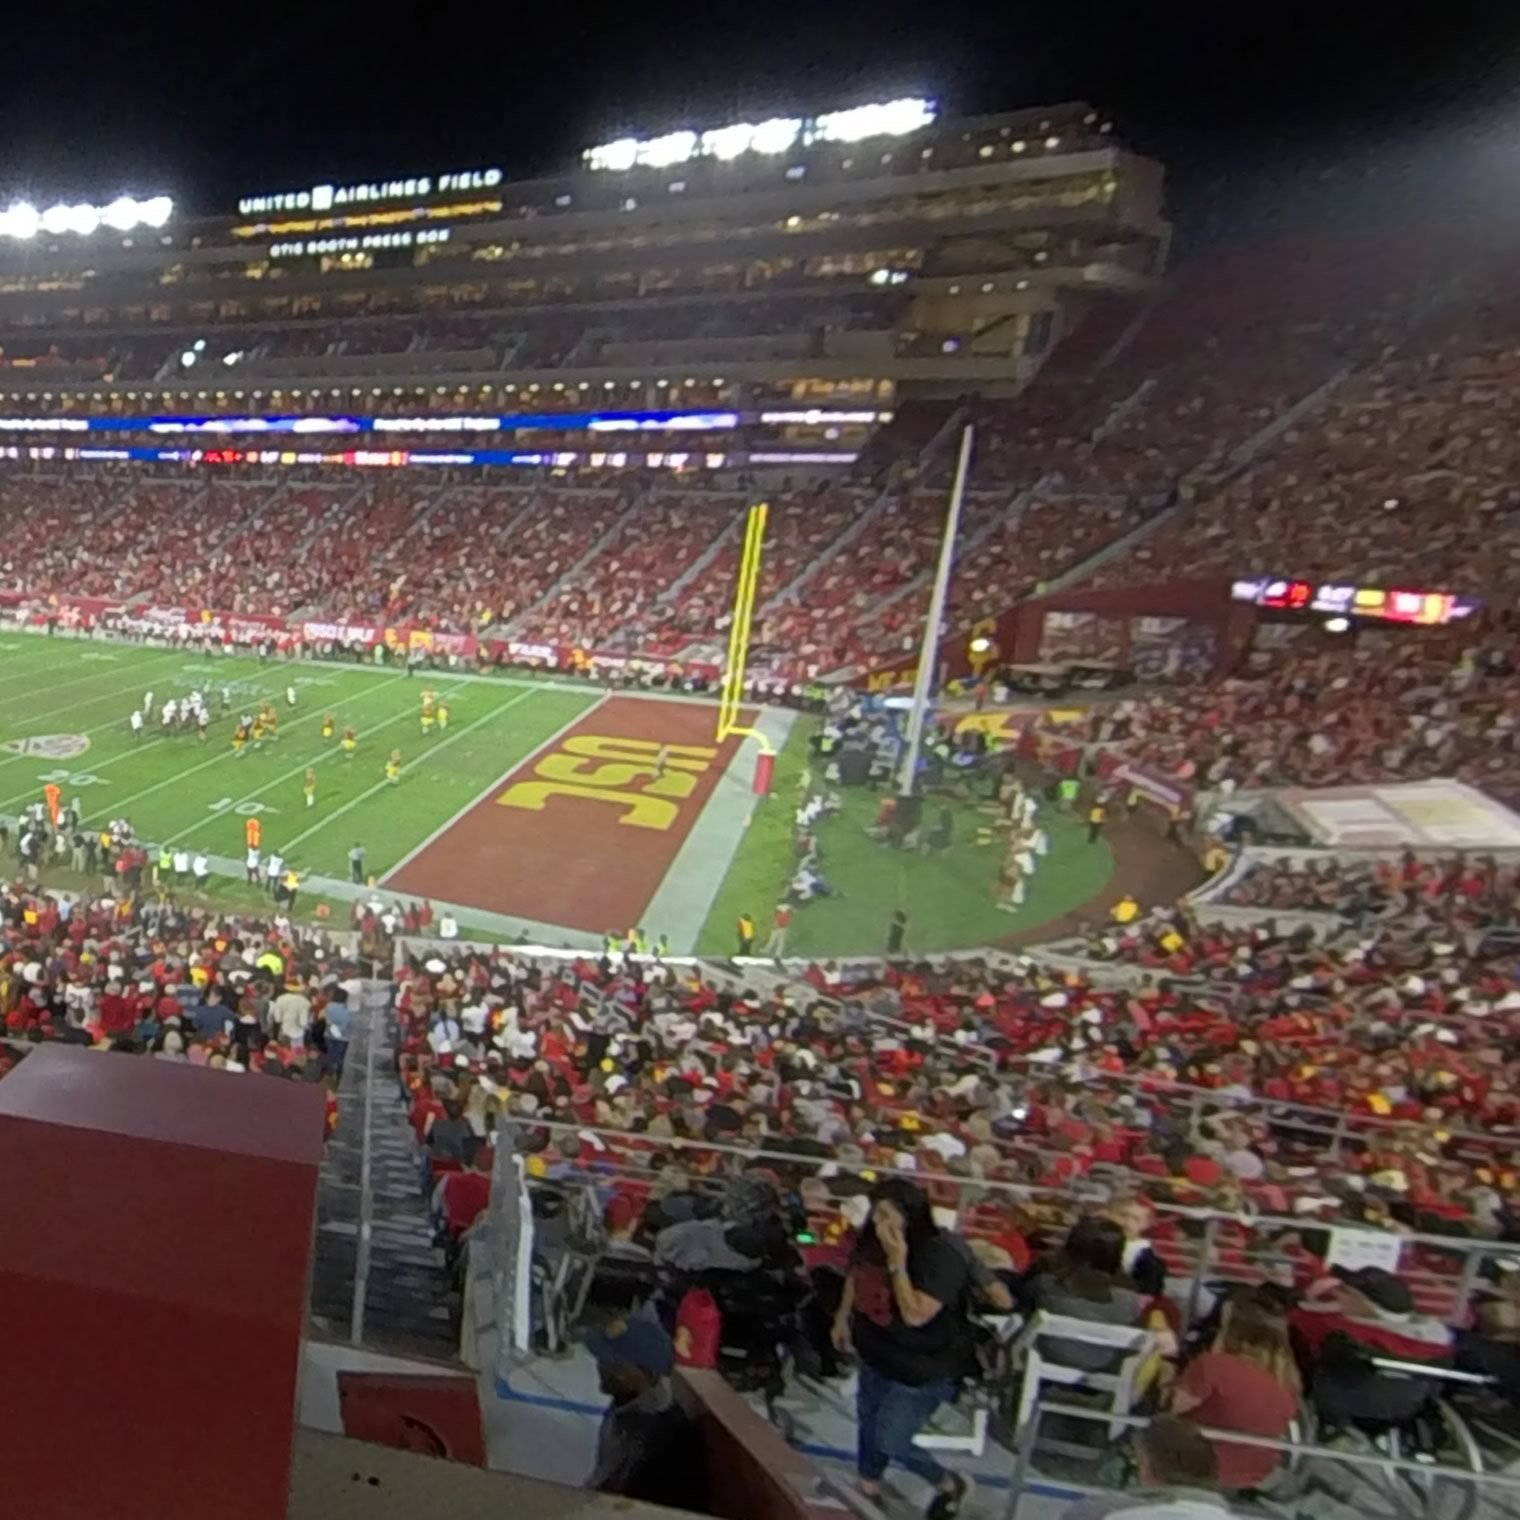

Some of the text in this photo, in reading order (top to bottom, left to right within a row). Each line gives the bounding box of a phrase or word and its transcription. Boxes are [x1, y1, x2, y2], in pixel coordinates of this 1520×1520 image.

[238, 168, 502, 214] UNITED AIRLINES FIELD
[269, 228, 450, 257] OTIS BOOTH PRESS BOX
